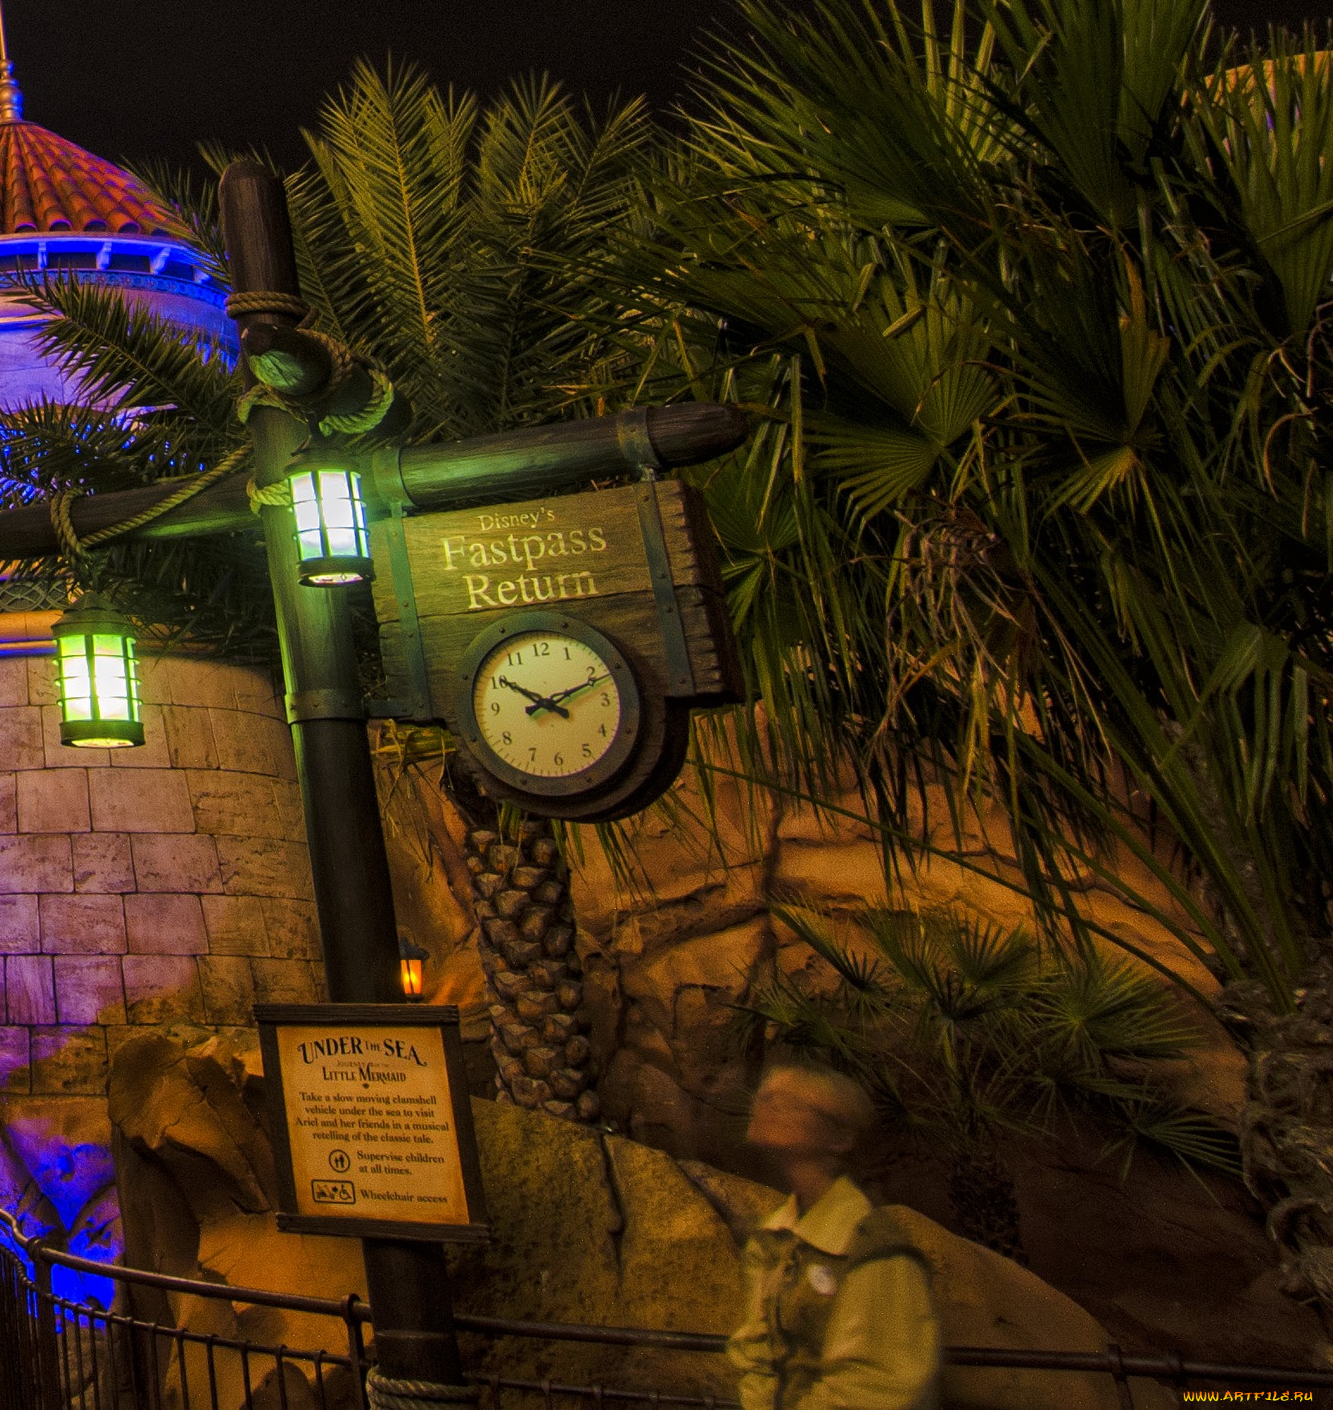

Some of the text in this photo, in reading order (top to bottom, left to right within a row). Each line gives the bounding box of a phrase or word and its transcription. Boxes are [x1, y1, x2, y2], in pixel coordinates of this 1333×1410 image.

[478, 507, 555, 531] Disney's
[439, 527, 607, 571] Fastpass
[462, 571, 600, 609] Return
[532, 642, 550, 657] 12
[563, 647, 571, 660] 1
[507, 652, 523, 666] 11
[586, 666, 596, 681] 2
[491, 675, 508, 690] 10
[601, 693, 611, 707] 3
[491, 702, 500, 716] 9
[598, 723, 607, 737] 4
[502, 731, 513, 746] 8
[528, 747, 537, 762] 7
[582, 743, 592, 758] 5
[554, 752, 564, 766] 6
[297, 1036, 364, 1064] UNDER
[383, 1038, 428, 1067] SEA
[322, 1066, 356, 1081] LITTLE
[359, 1062, 406, 1084] MERMAID
[299, 1092, 323, 1102] Take
[333, 1093, 354, 1103] slow
[356, 1094, 391, 1105] moving
[392, 1094, 437, 1105] clamshell
[305, 1105, 435, 1118] vehicle under the sea to visit
[295, 1117, 318, 1127] Ariel
[321, 1118, 338, 1128] and
[340, 1119, 356, 1129] her
[358, 1119, 390, 1130] friends
[392, 1120, 402, 1130] in
[413, 1121, 450, 1131] musical
[313, 1130, 434, 1144] retelling of the classic tale.
[356, 1151, 445, 1163] Supervise children
[359, 1164, 413, 1175] at all times.
[360, 1189, 448, 1204] Wheelchair access
